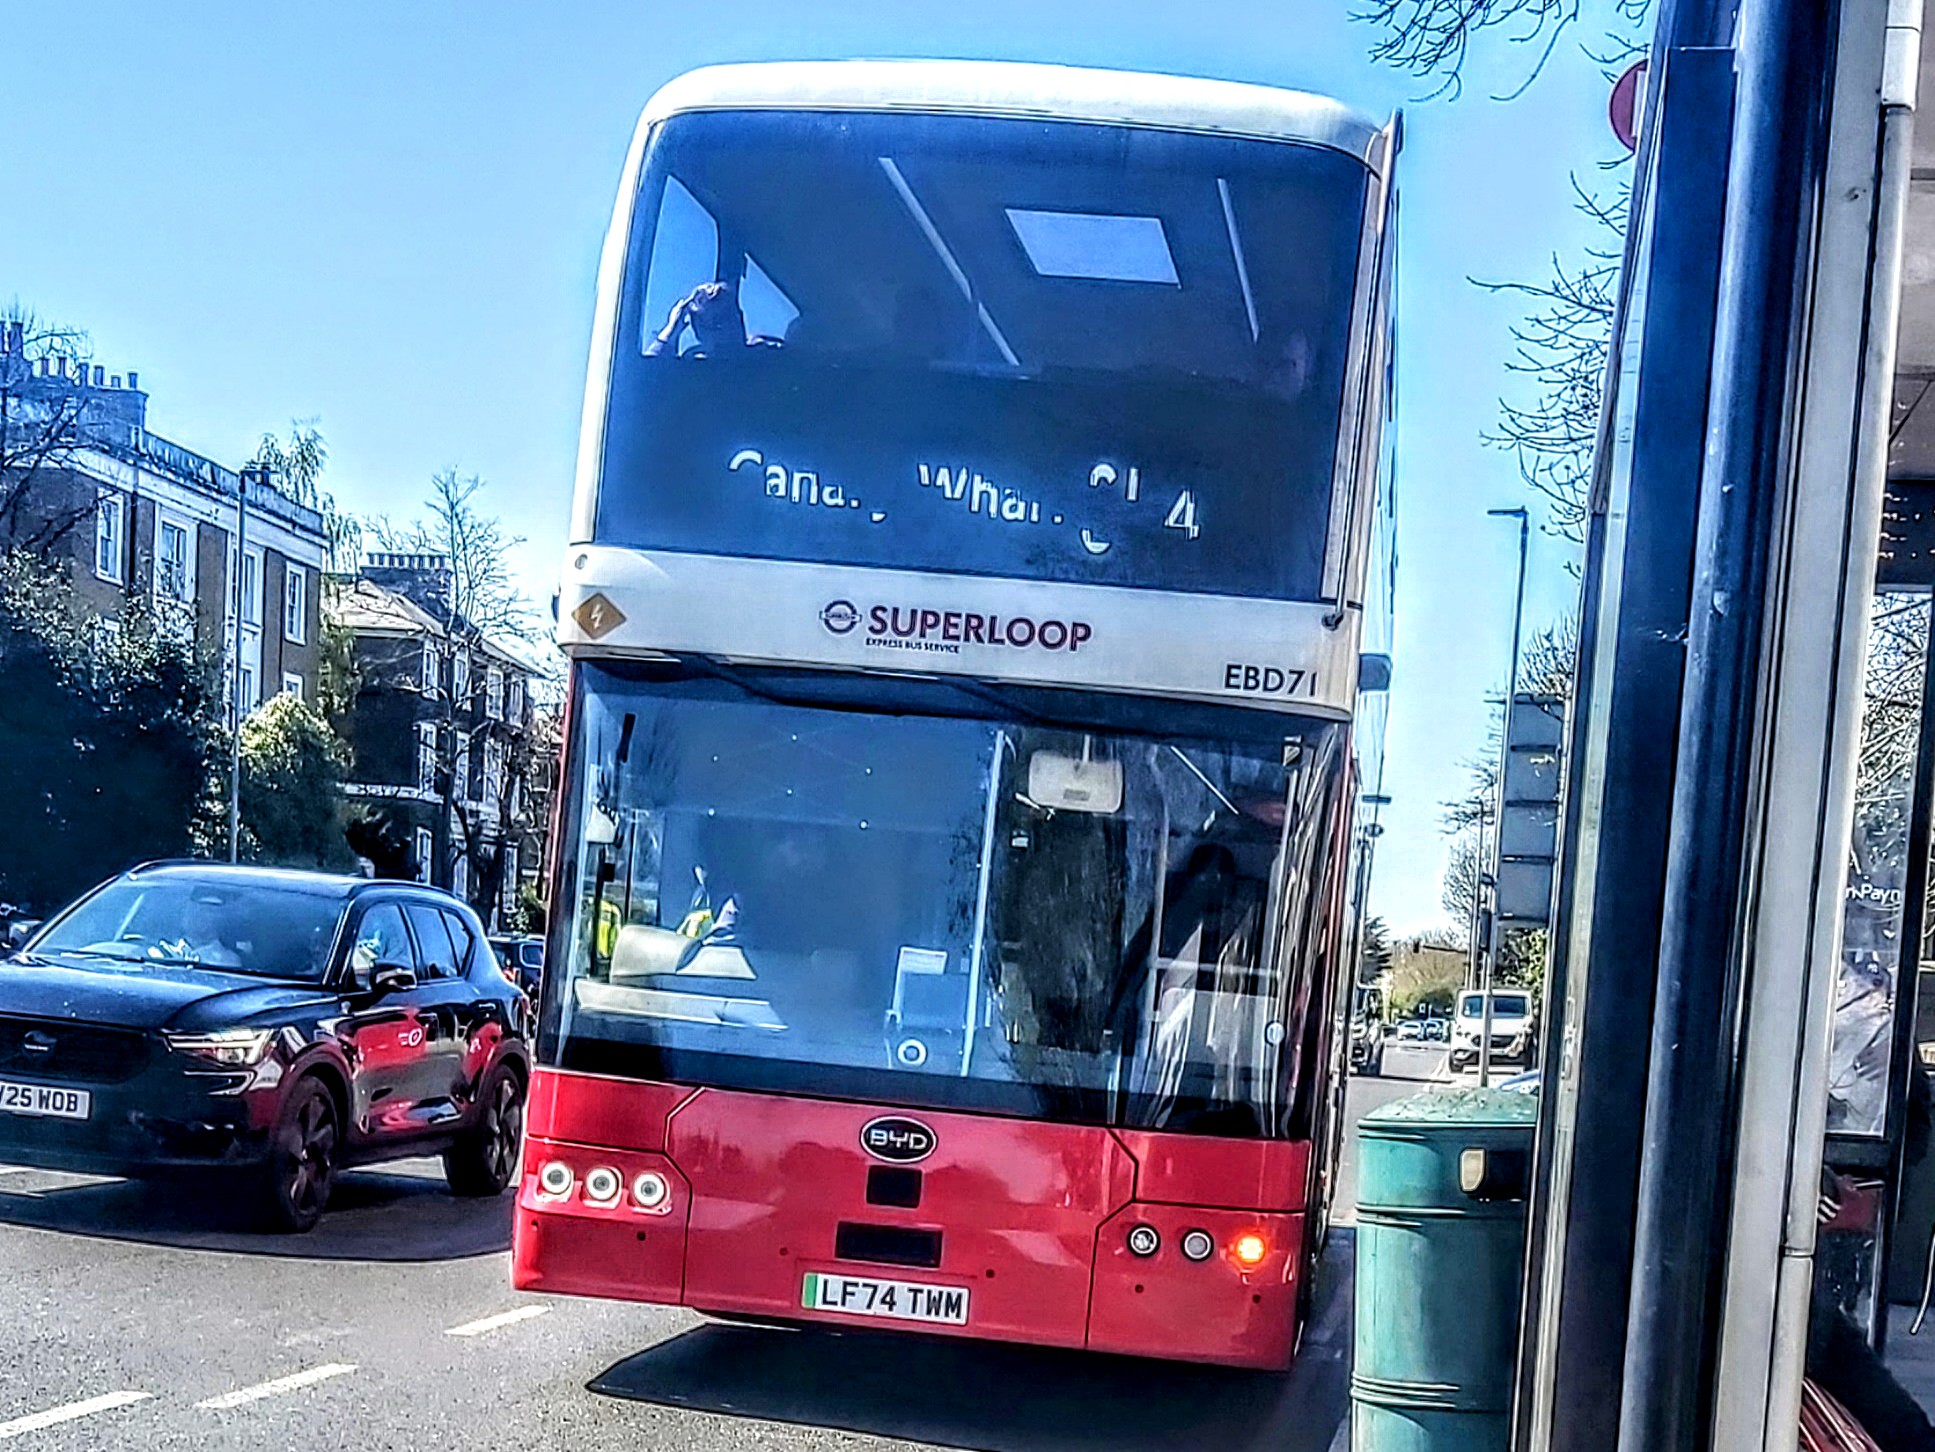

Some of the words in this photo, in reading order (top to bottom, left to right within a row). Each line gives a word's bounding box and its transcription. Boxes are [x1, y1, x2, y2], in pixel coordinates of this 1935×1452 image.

[868, 605, 1092, 651] SUPERLOOP
[866, 637, 903, 649] EXPRESS
[905, 640, 922, 650] BUS
[924, 642, 960, 654] SERVICE
[1225, 664, 1317, 697] EBD71
[39, 1089, 78, 1113] WOB
[869, 1128, 928, 1150] BYD
[821, 1278, 897, 1312] LF74
[908, 1287, 963, 1320] TWM
